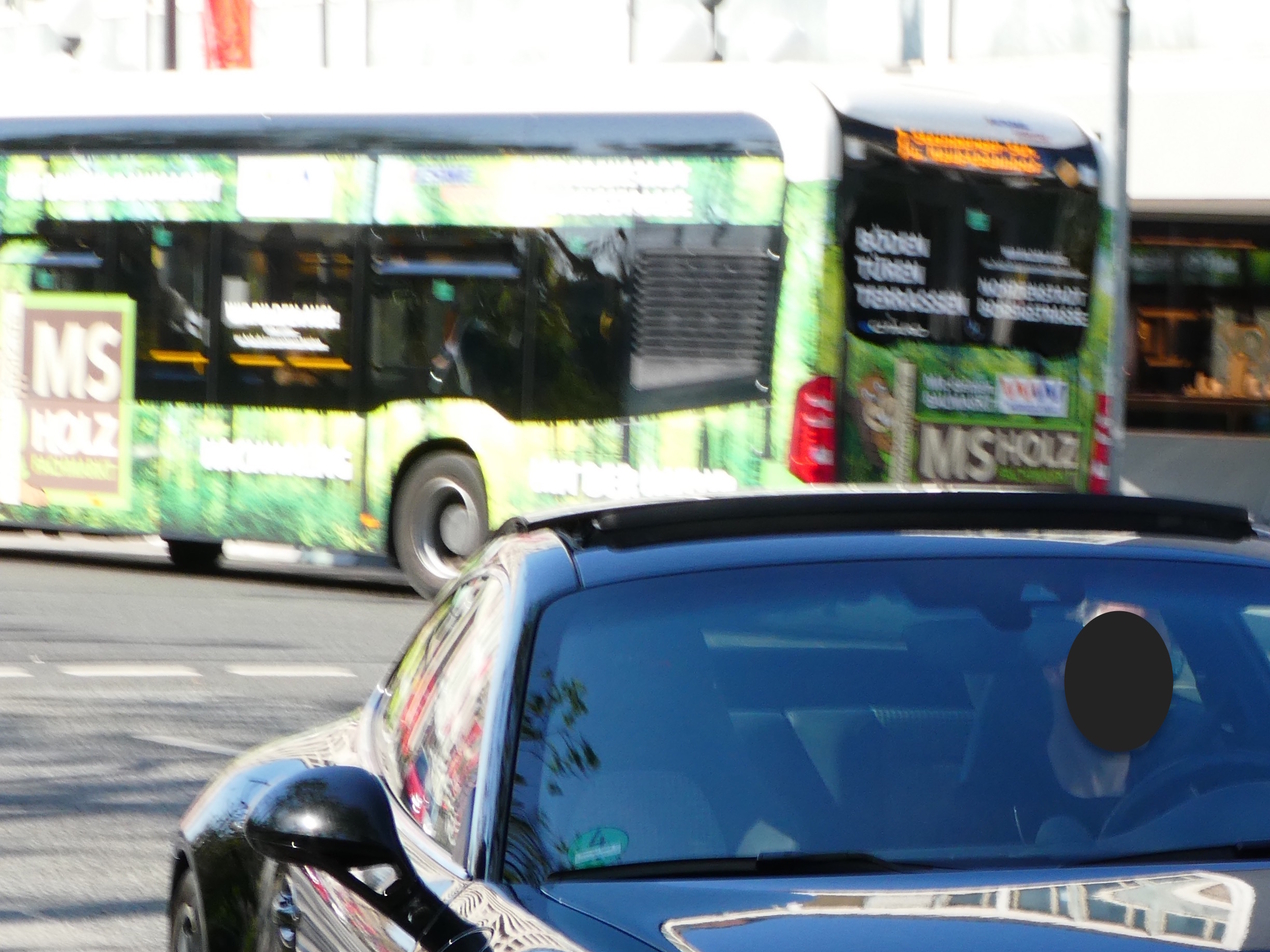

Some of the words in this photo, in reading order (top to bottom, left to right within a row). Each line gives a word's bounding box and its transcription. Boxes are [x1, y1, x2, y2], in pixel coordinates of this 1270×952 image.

[33, 320, 122, 402] MS
[30, 407, 119, 455] HOLZ
[920, 423, 996, 482] MS
[995, 430, 1079, 469] HOLZ
